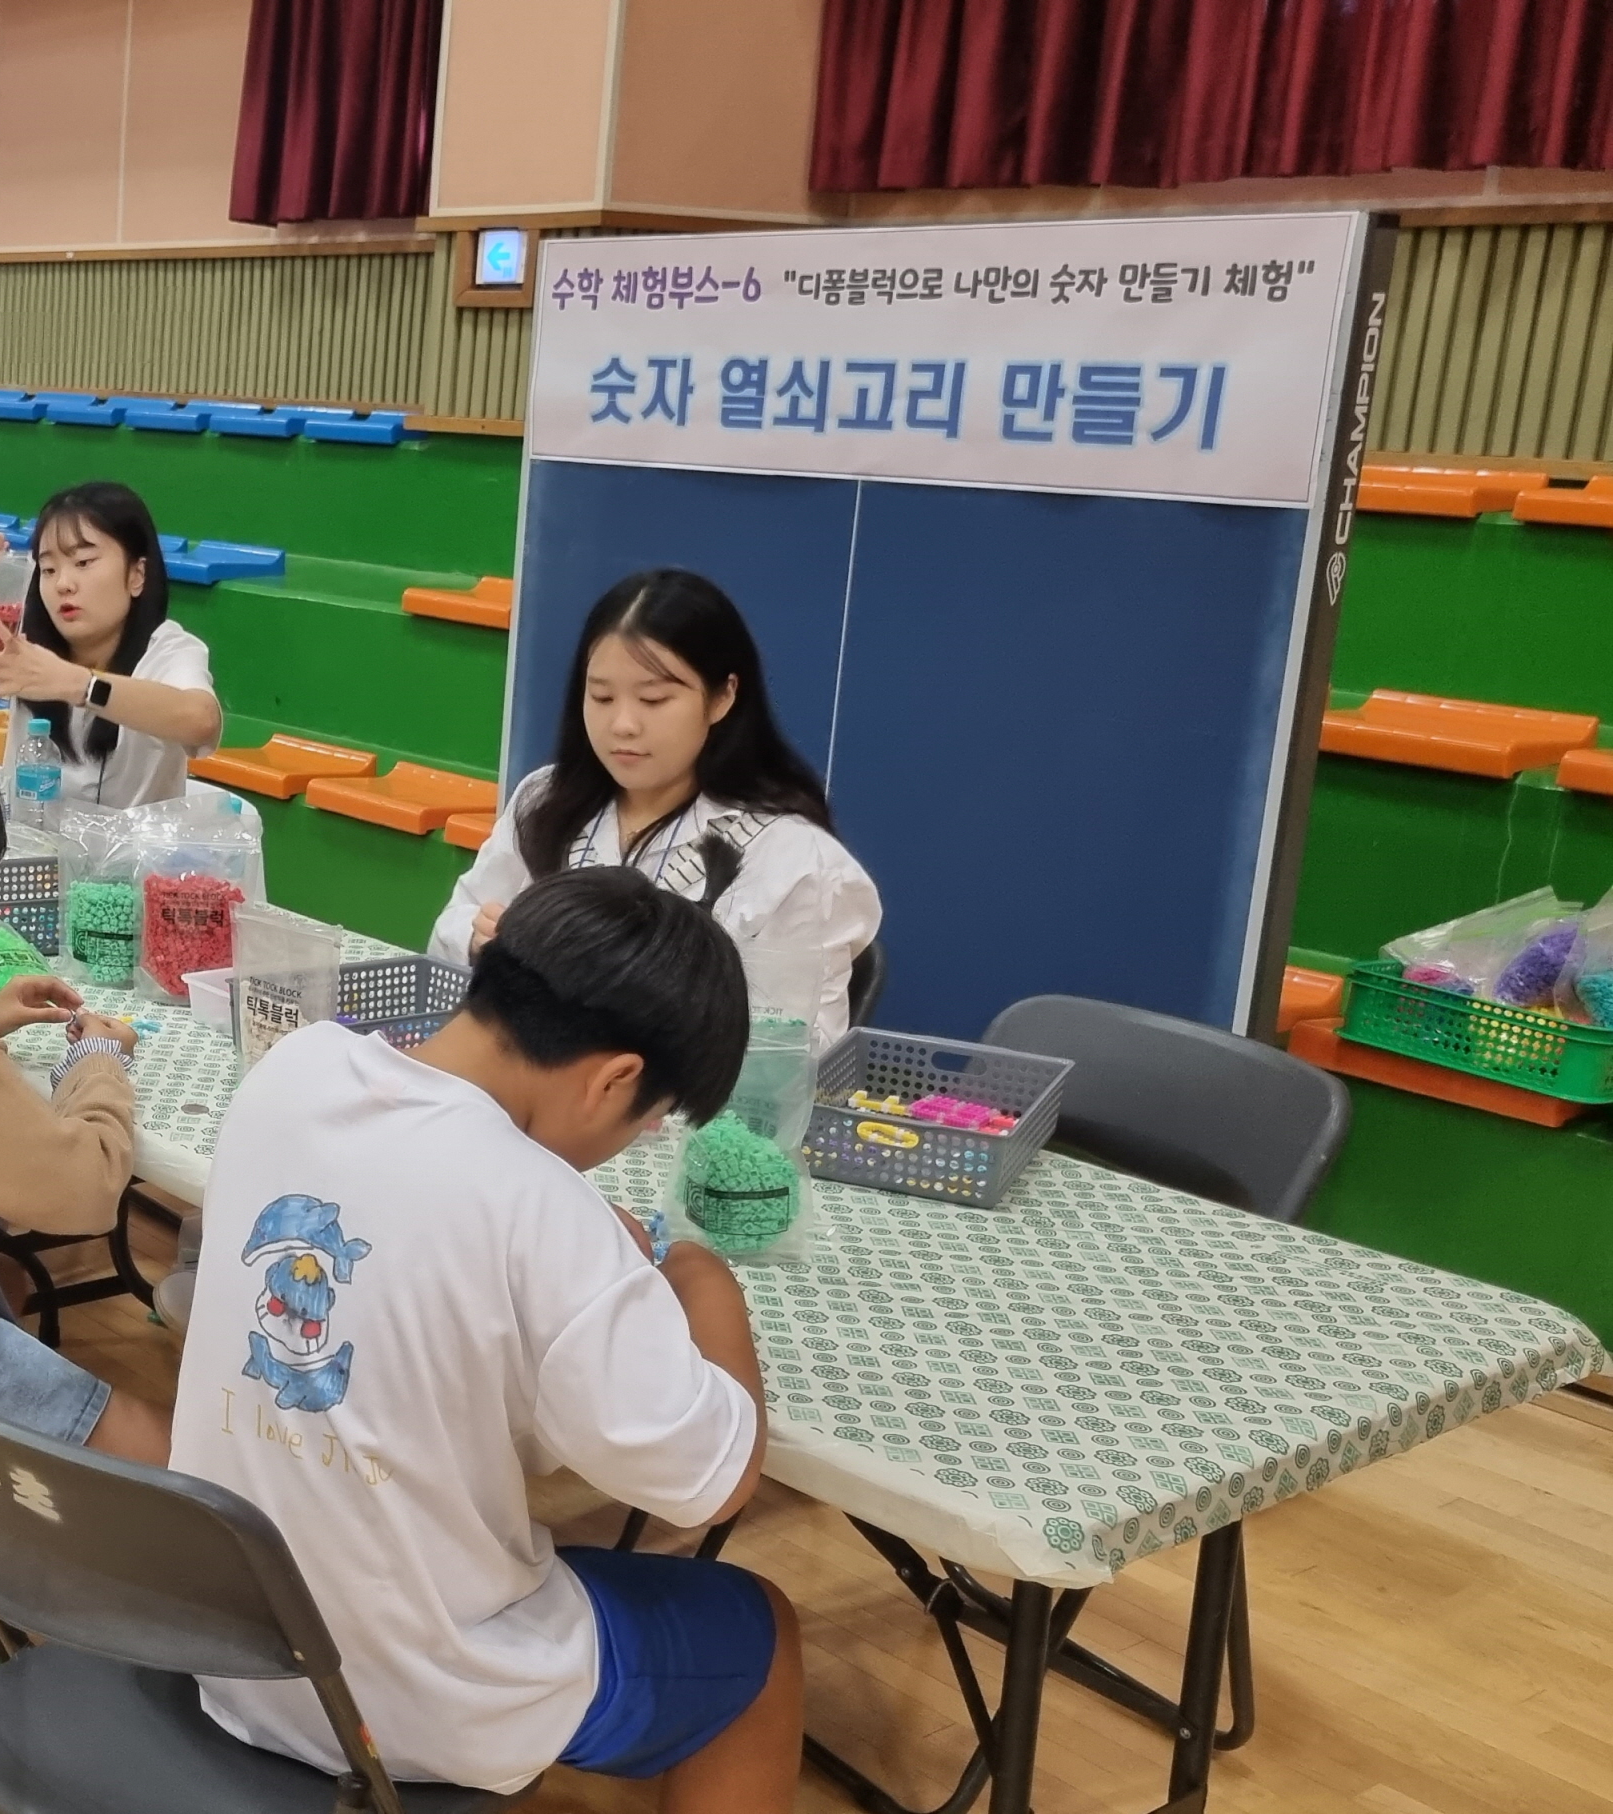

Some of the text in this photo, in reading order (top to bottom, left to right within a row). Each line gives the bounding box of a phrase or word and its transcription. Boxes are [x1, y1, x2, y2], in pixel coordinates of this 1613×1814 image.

[551, 266, 762, 310] 수학 체험부스-6
[783, 259, 1316, 306] "디폼블럭으로 나만의 숫자 만들기 체험"
[590, 357, 1226, 451] 숫자 열쇠고리 만들기
[1335, 292, 1385, 545] CHAMPION
[162, 907, 224, 927] 틱톡블럭
[249, 976, 302, 998] TICK TOCK BLOCK
[246, 995, 298, 1028] 틱톡블럭
[221, 1387, 235, 1435] I
[257, 1404, 303, 1460] love
